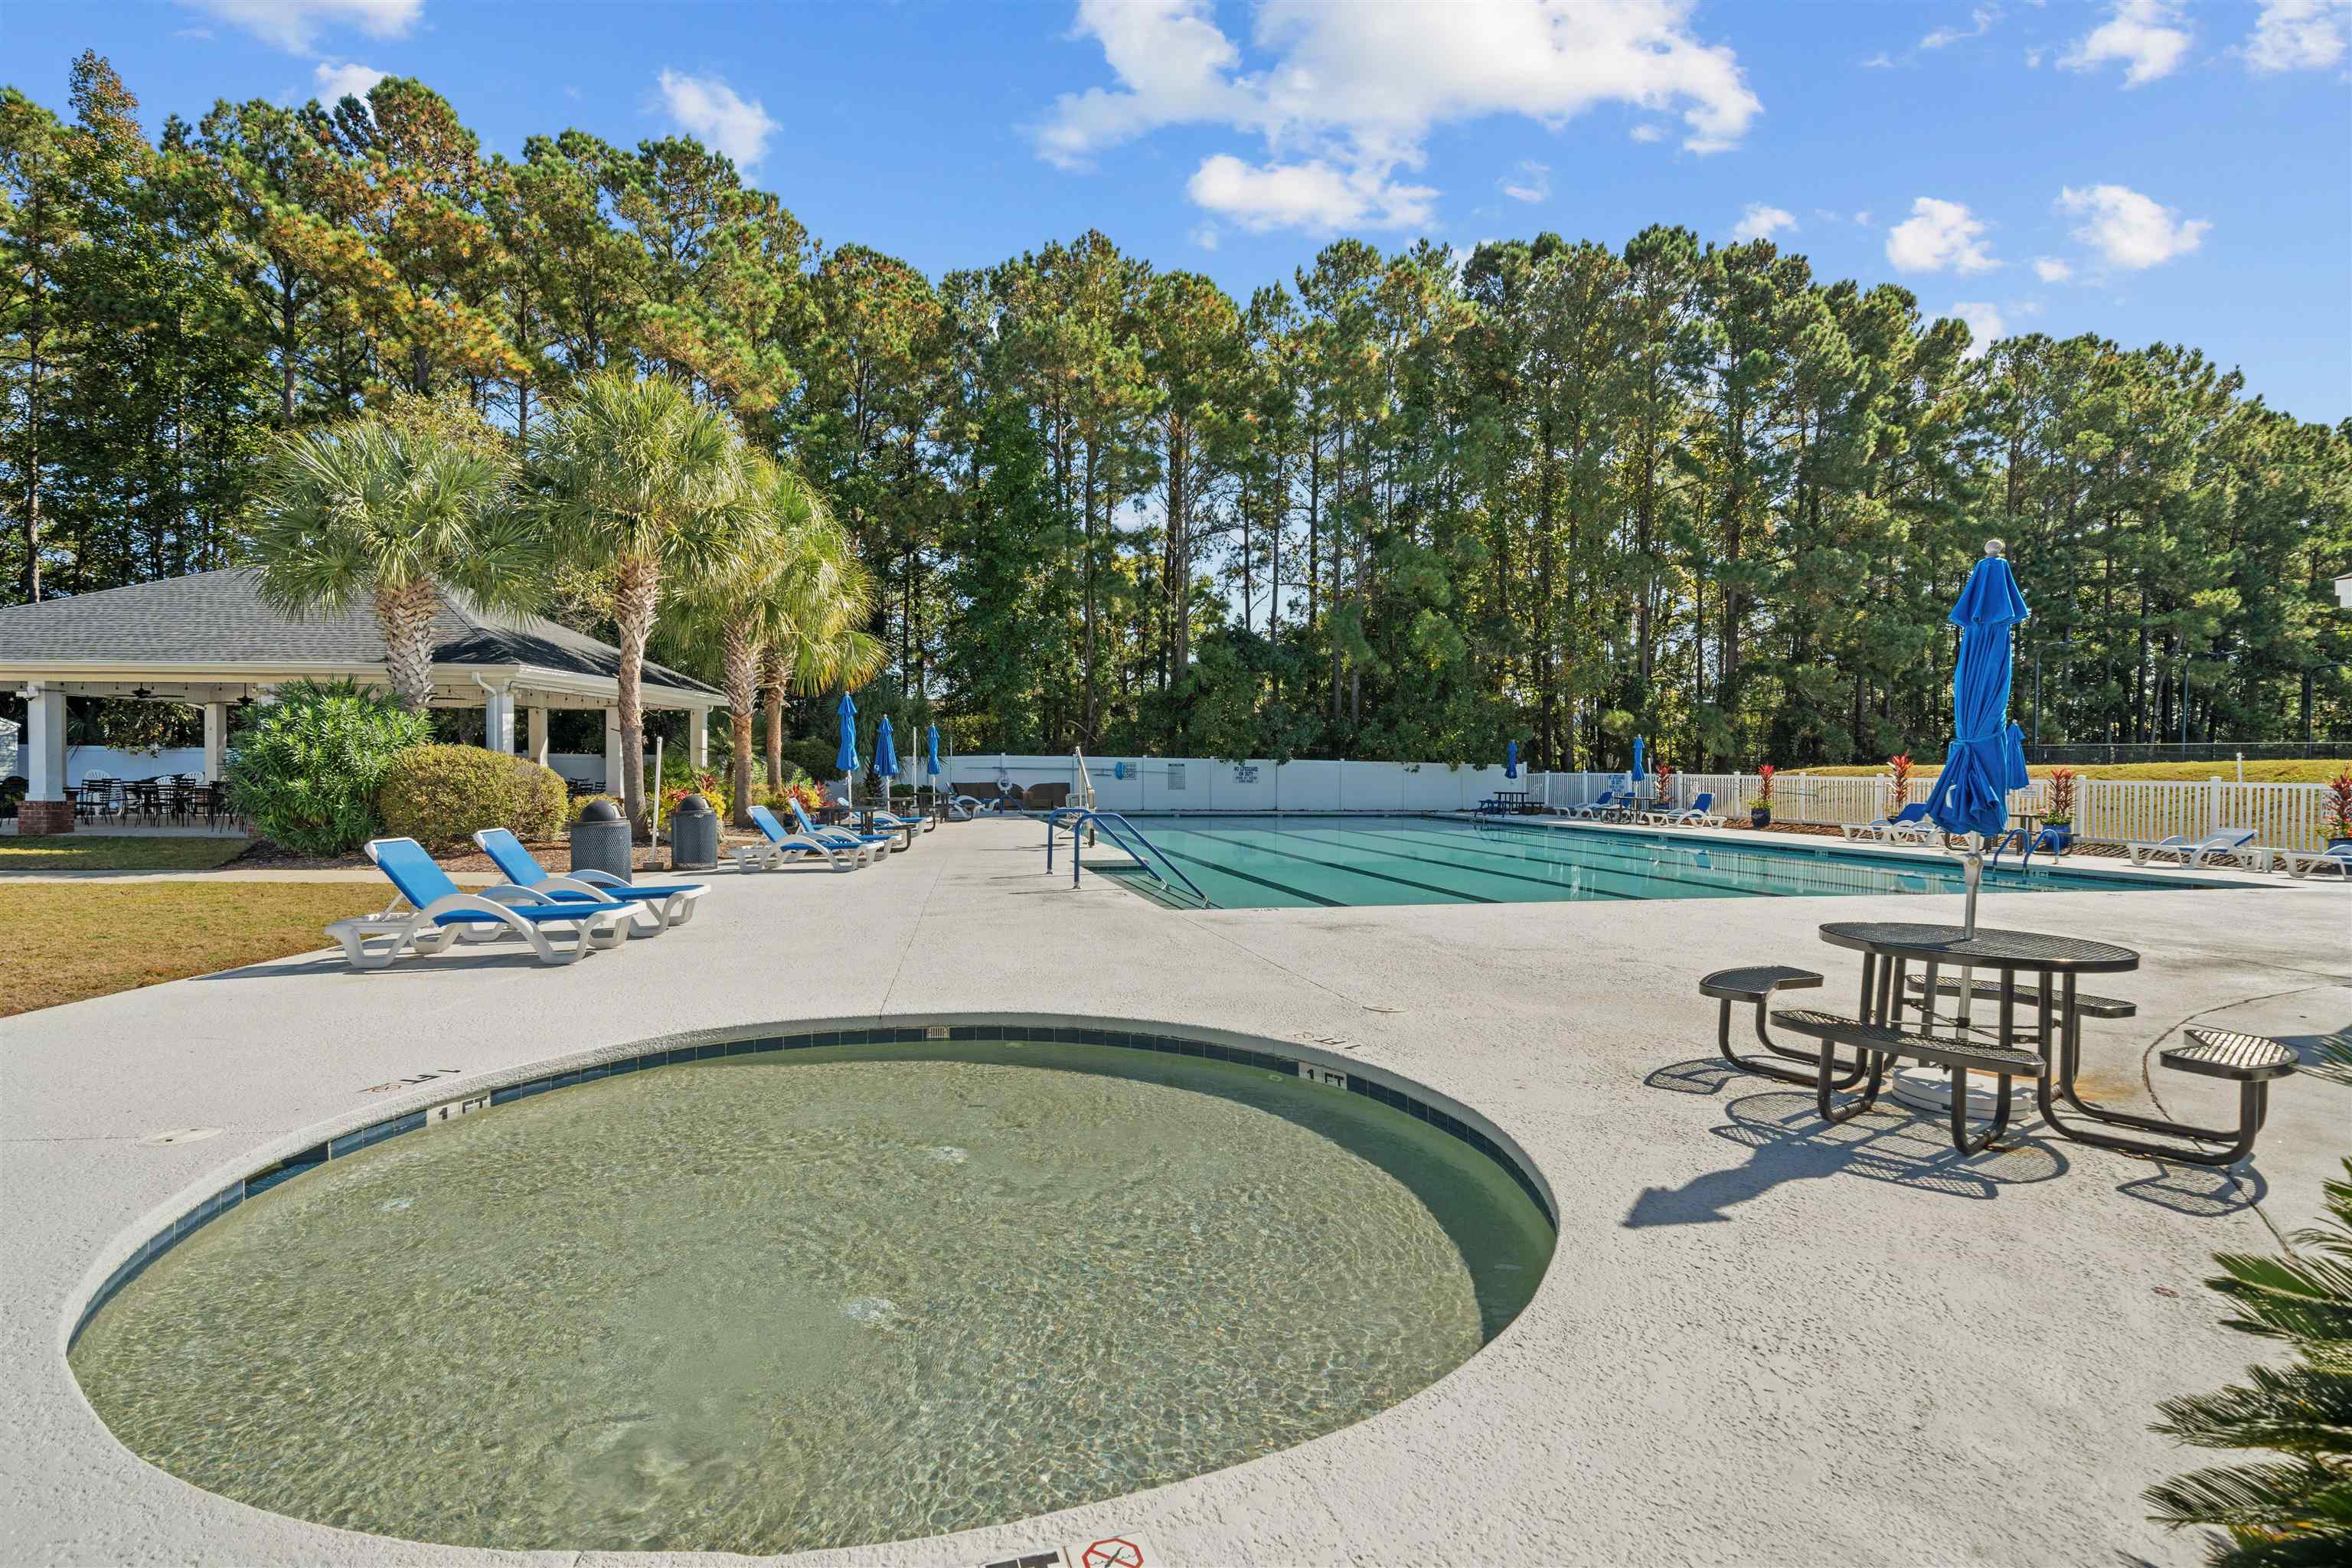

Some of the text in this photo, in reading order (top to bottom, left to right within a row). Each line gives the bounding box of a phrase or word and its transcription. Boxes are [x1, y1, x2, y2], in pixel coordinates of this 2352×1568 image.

[1307, 1068, 1344, 1087] 1 FT
[439, 1096, 488, 1119] 1 FT
